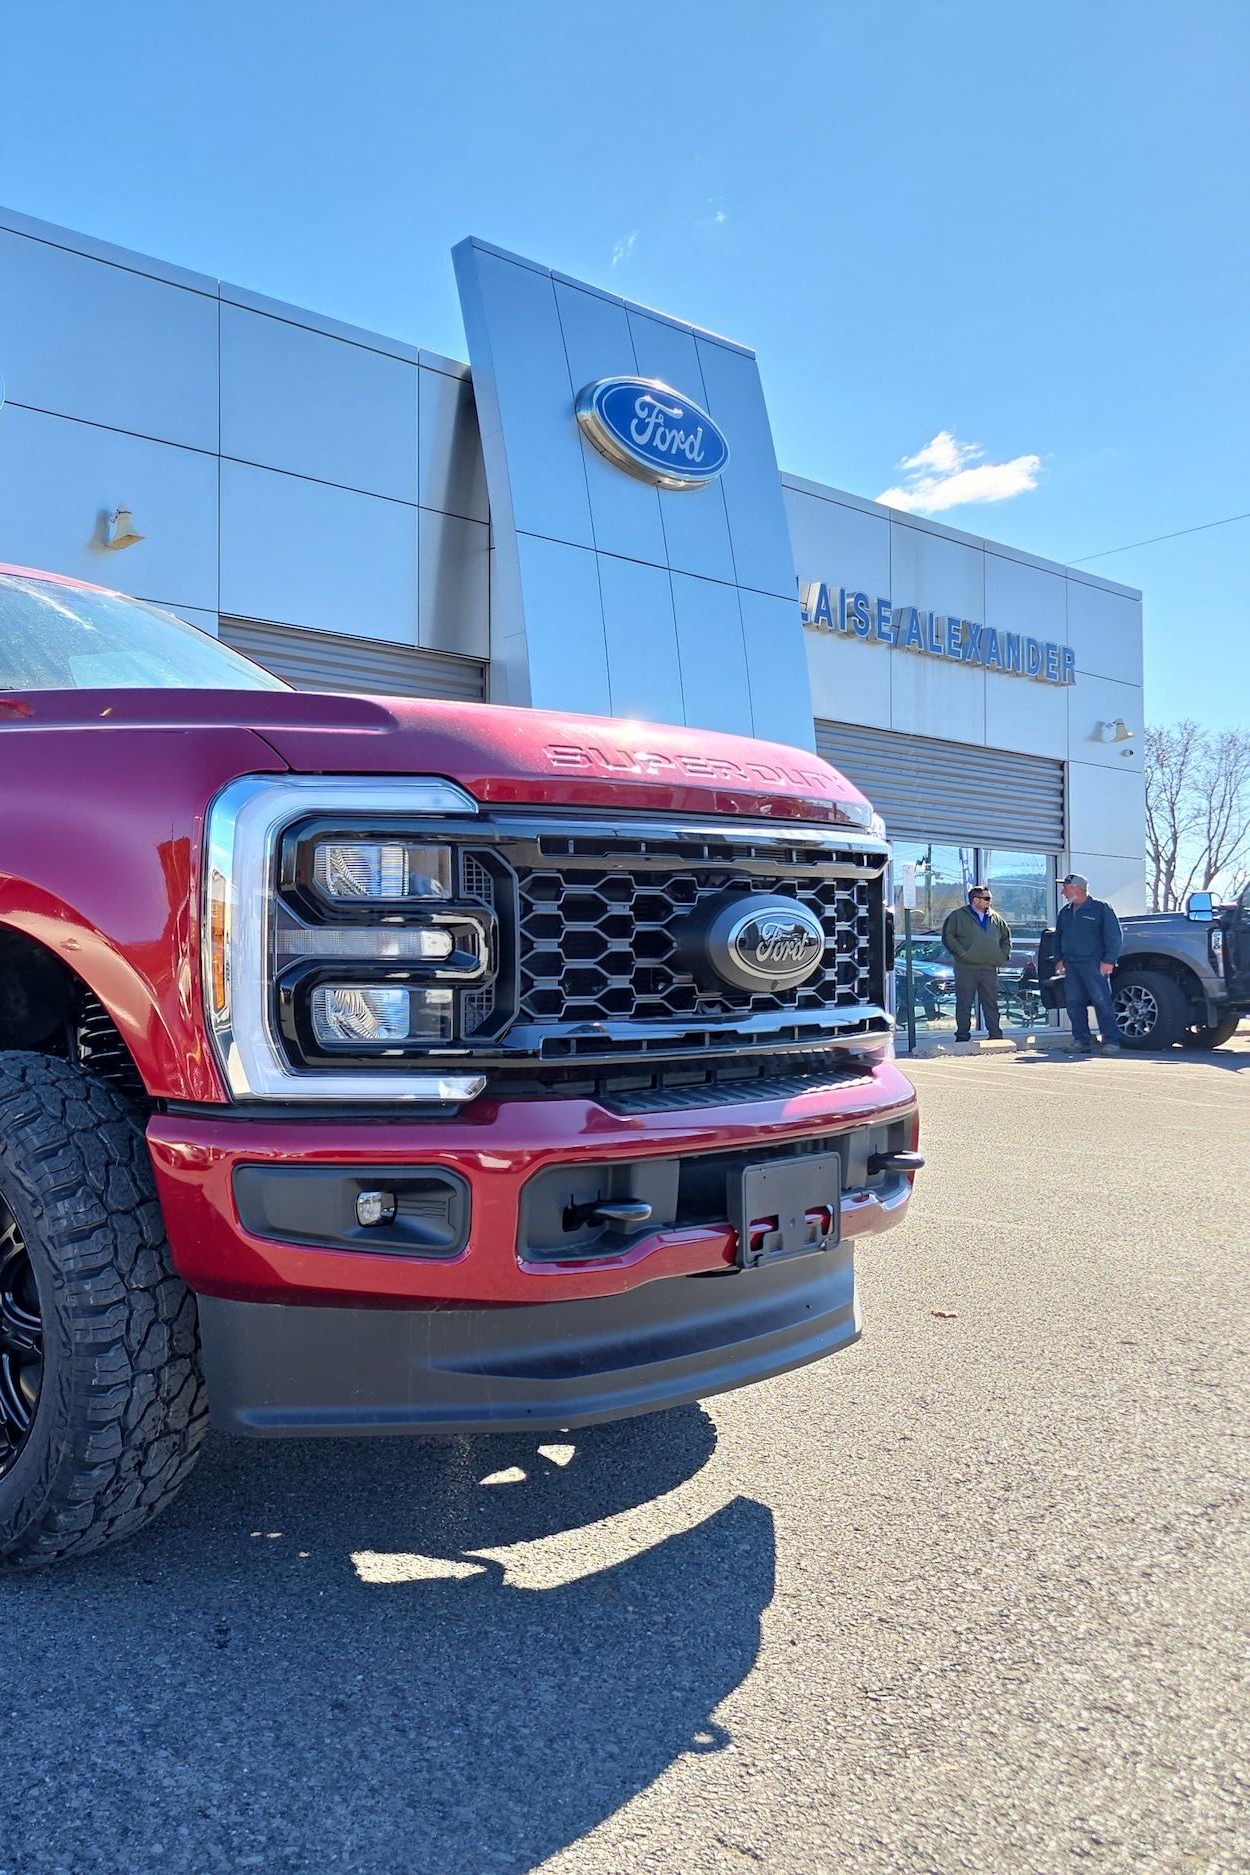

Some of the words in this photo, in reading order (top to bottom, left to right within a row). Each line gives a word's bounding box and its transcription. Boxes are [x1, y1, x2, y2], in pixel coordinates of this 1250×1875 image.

[630, 395, 704, 463] Ford
[902, 606, 1076, 685] ALEXANDER
[543, 744, 751, 782] SUPER
[755, 922, 809, 961] Ford
